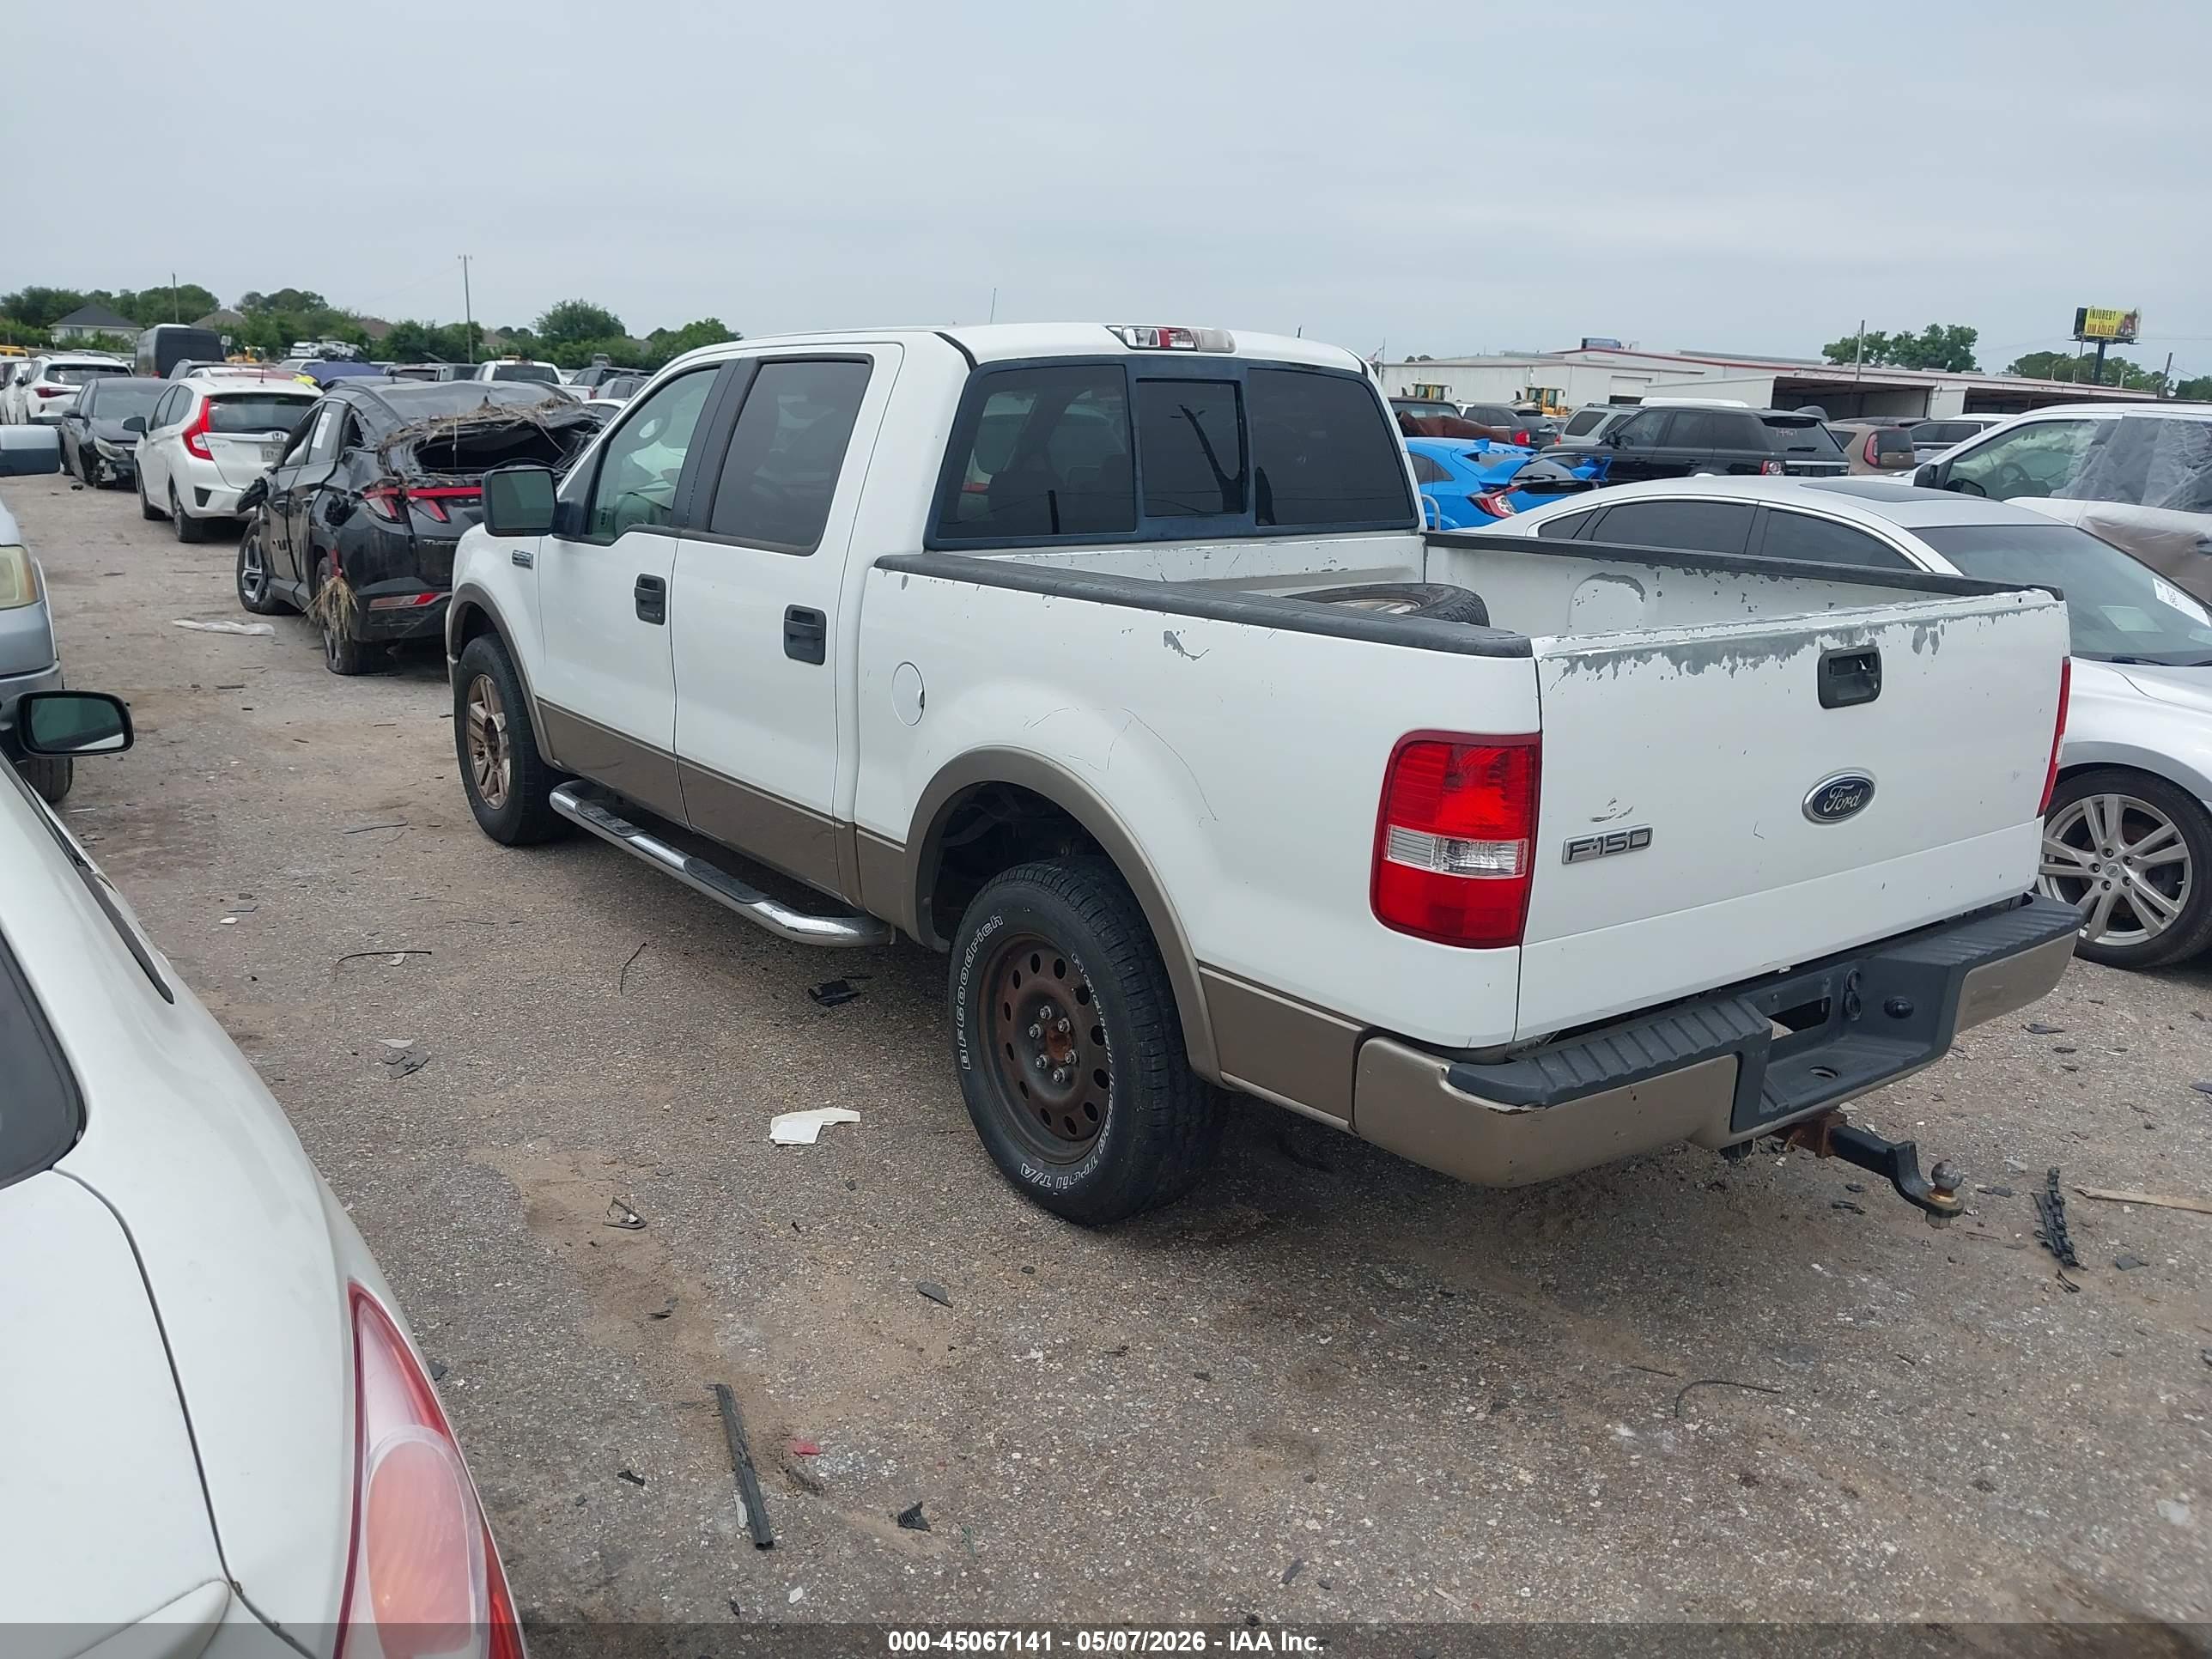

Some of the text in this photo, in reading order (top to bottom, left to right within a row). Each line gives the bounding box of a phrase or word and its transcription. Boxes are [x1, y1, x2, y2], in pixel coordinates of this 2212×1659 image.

[2089, 308, 2117, 320] INJURED?
[1823, 783, 1863, 813] Ford
[952, 915, 1004, 1071] BFGoodrich
[1020, 1161, 1052, 1189] T/A
[1055, 1155, 1099, 1190] Trail
